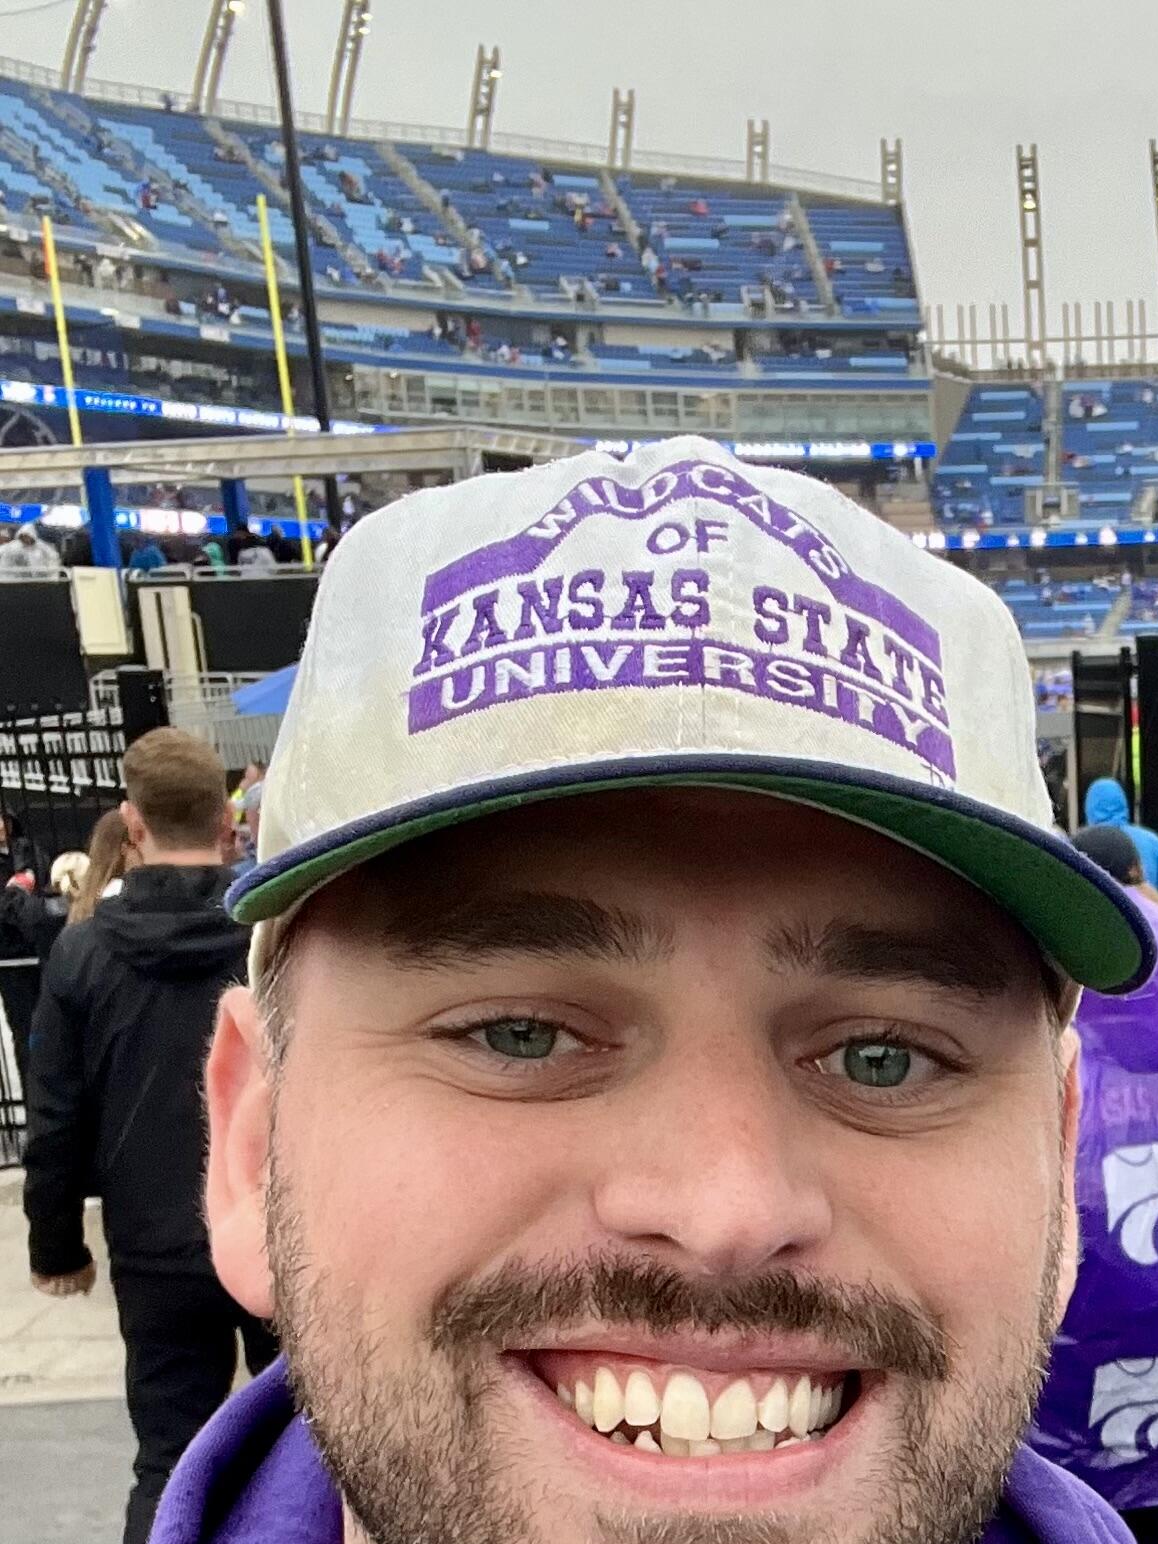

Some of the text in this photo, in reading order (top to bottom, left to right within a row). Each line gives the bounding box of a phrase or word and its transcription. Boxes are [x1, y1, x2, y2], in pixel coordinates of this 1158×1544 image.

[529, 462, 849, 579] WILDCATS
[646, 518, 729, 555] OF
[413, 568, 950, 729] KANSAS STATE
[440, 644, 932, 746] UNIVERSITY
